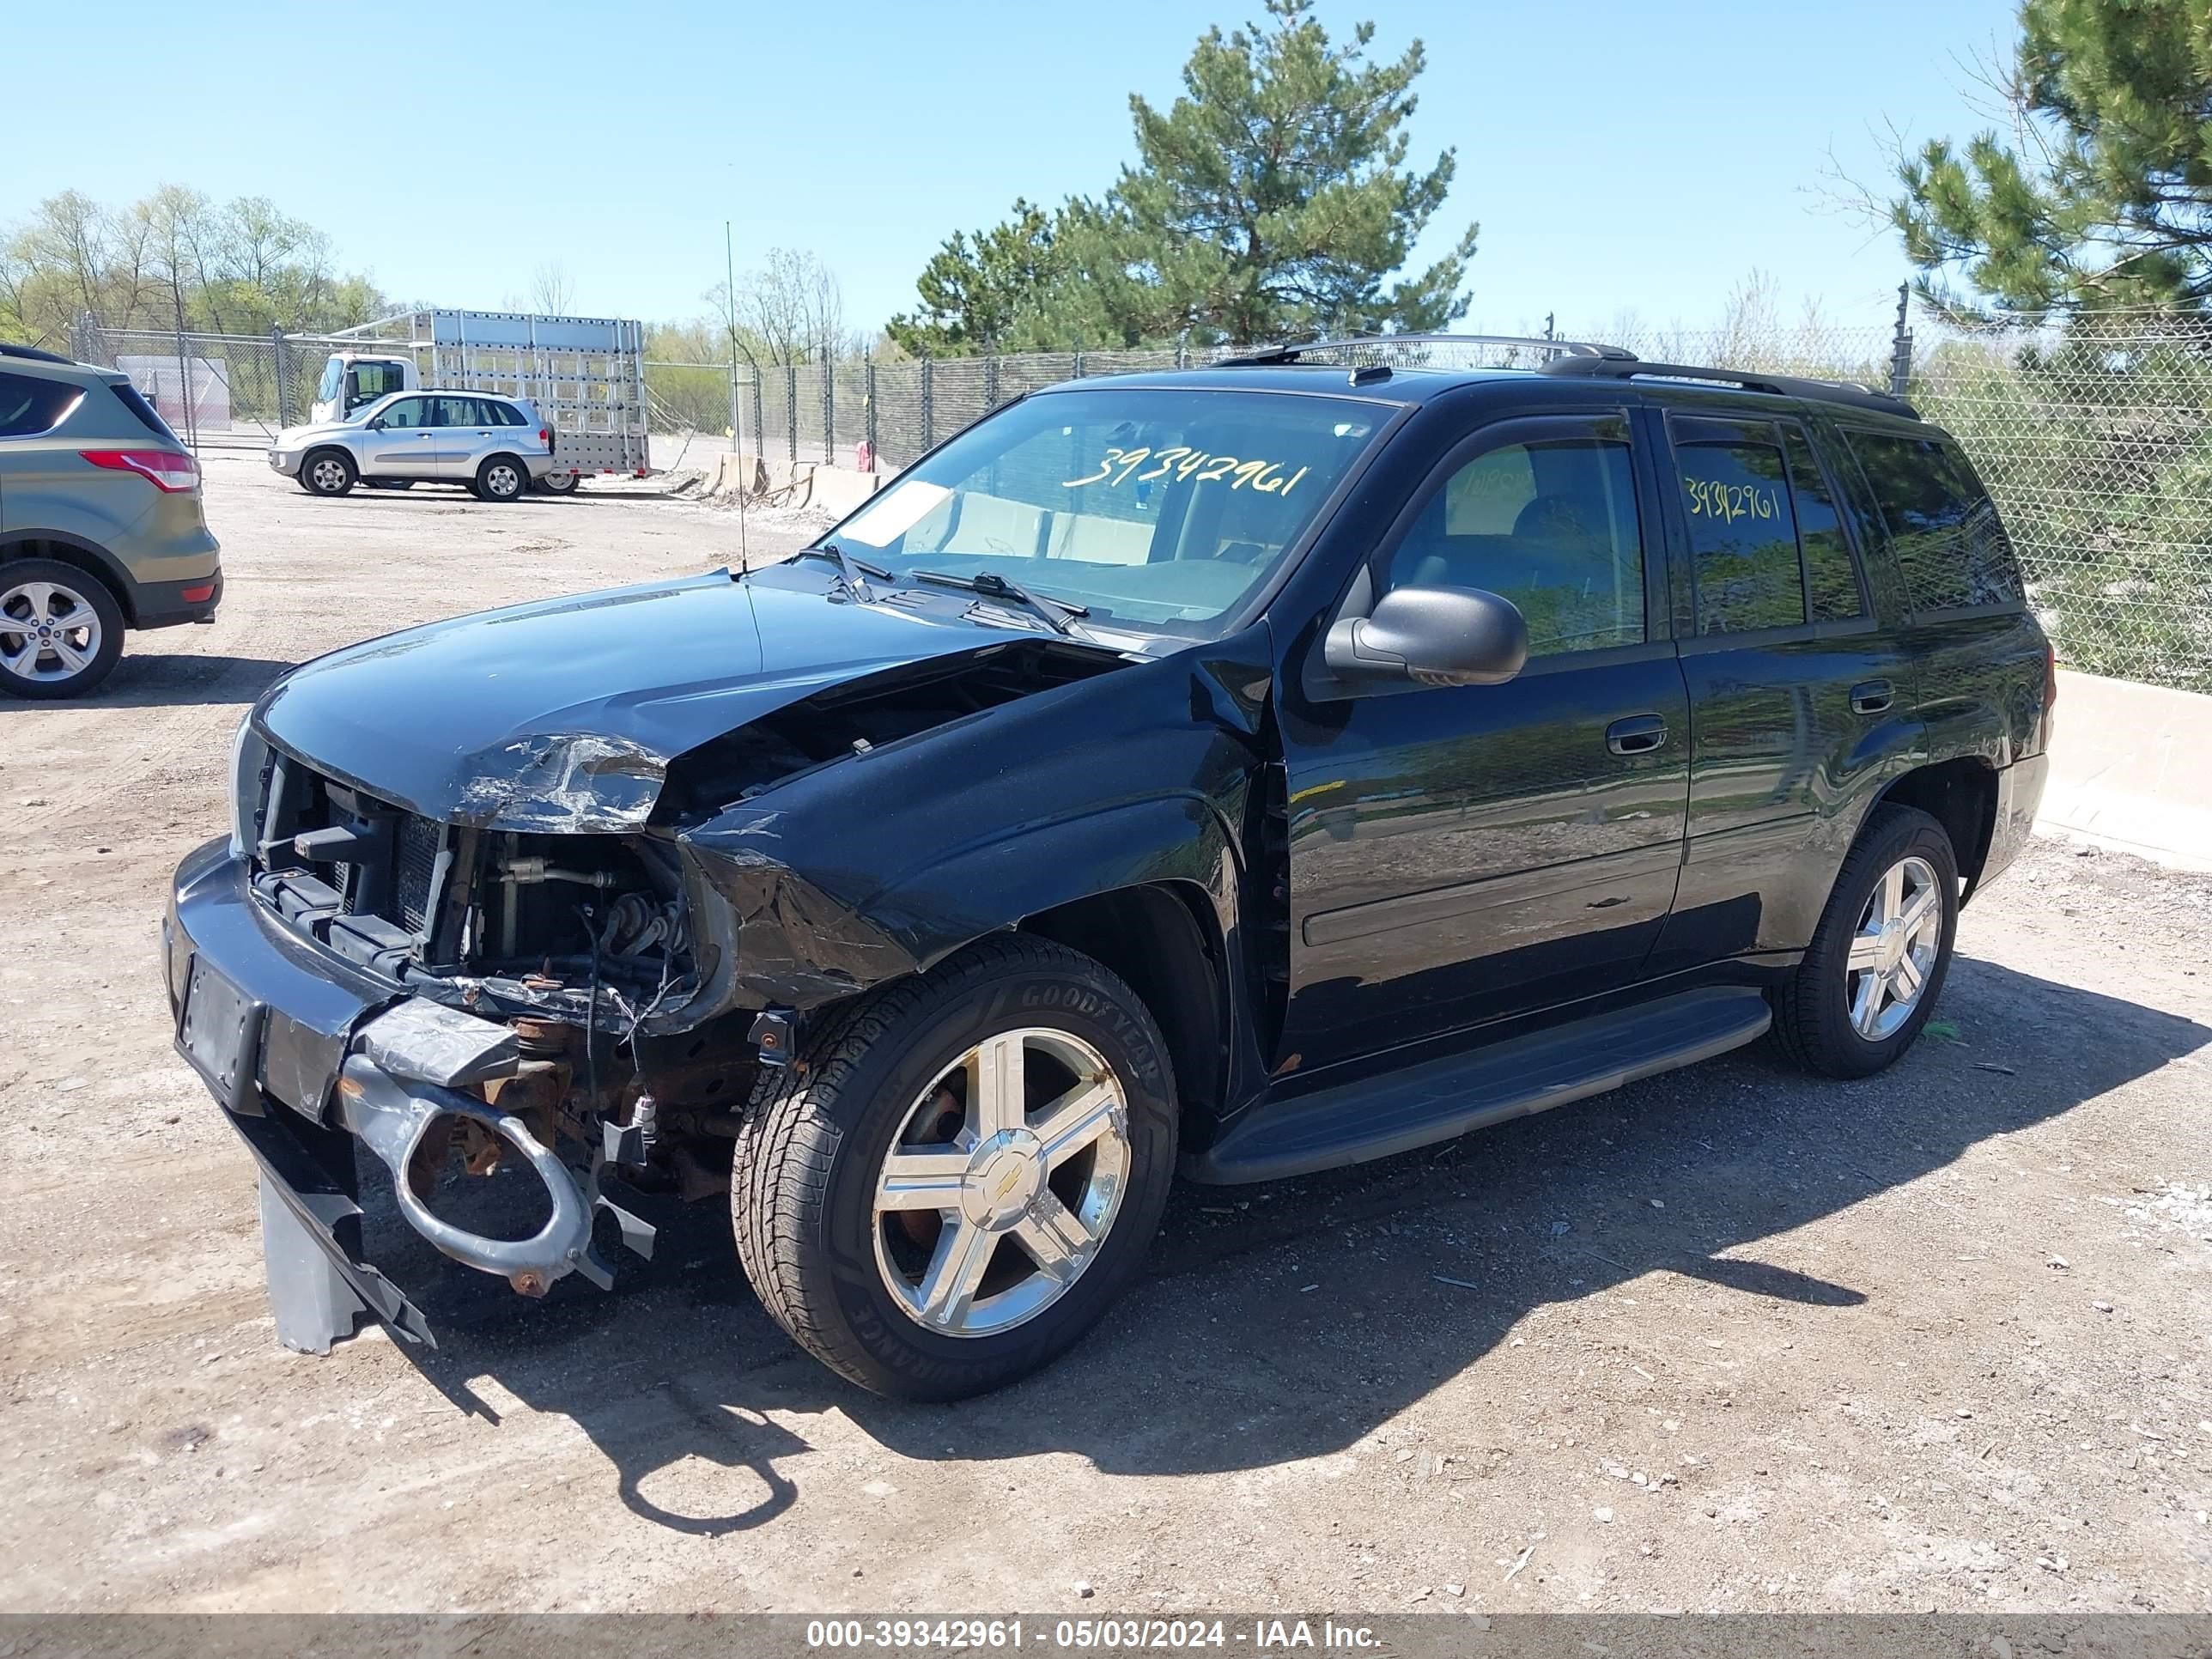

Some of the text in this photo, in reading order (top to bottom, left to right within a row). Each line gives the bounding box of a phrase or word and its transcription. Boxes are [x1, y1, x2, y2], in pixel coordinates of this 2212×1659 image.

[1061, 446, 1311, 497] 39342961
[1684, 477, 1781, 526] 39342961
[1022, 984, 1159, 1079] GOODYEAR
[849, 1304, 1007, 1382] URANCE
